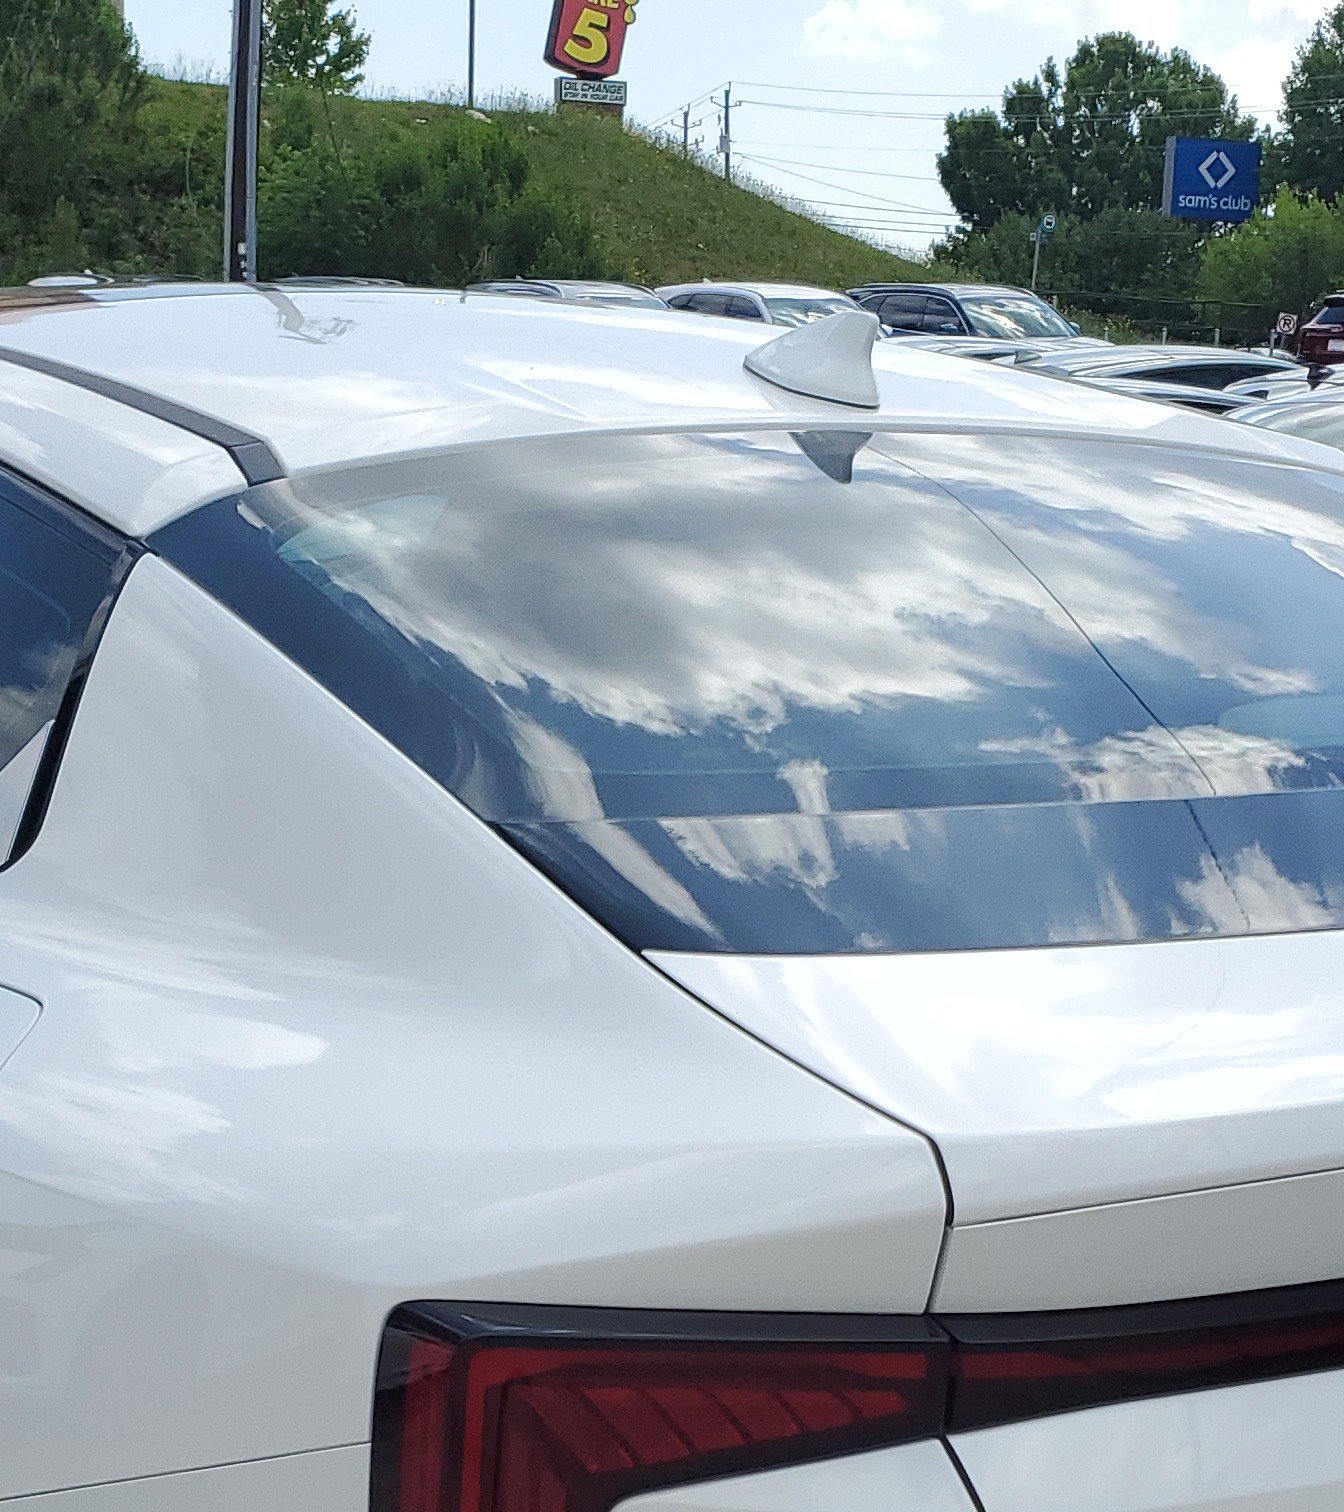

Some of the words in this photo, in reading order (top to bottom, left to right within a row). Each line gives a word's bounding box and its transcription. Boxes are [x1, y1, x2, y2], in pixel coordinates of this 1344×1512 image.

[563, 7, 609, 63] 5
[563, 81, 578, 91] OIL
[580, 83, 624, 94] CHANGE
[1178, 194, 1218, 209] sam's
[1220, 195, 1252, 211] club
